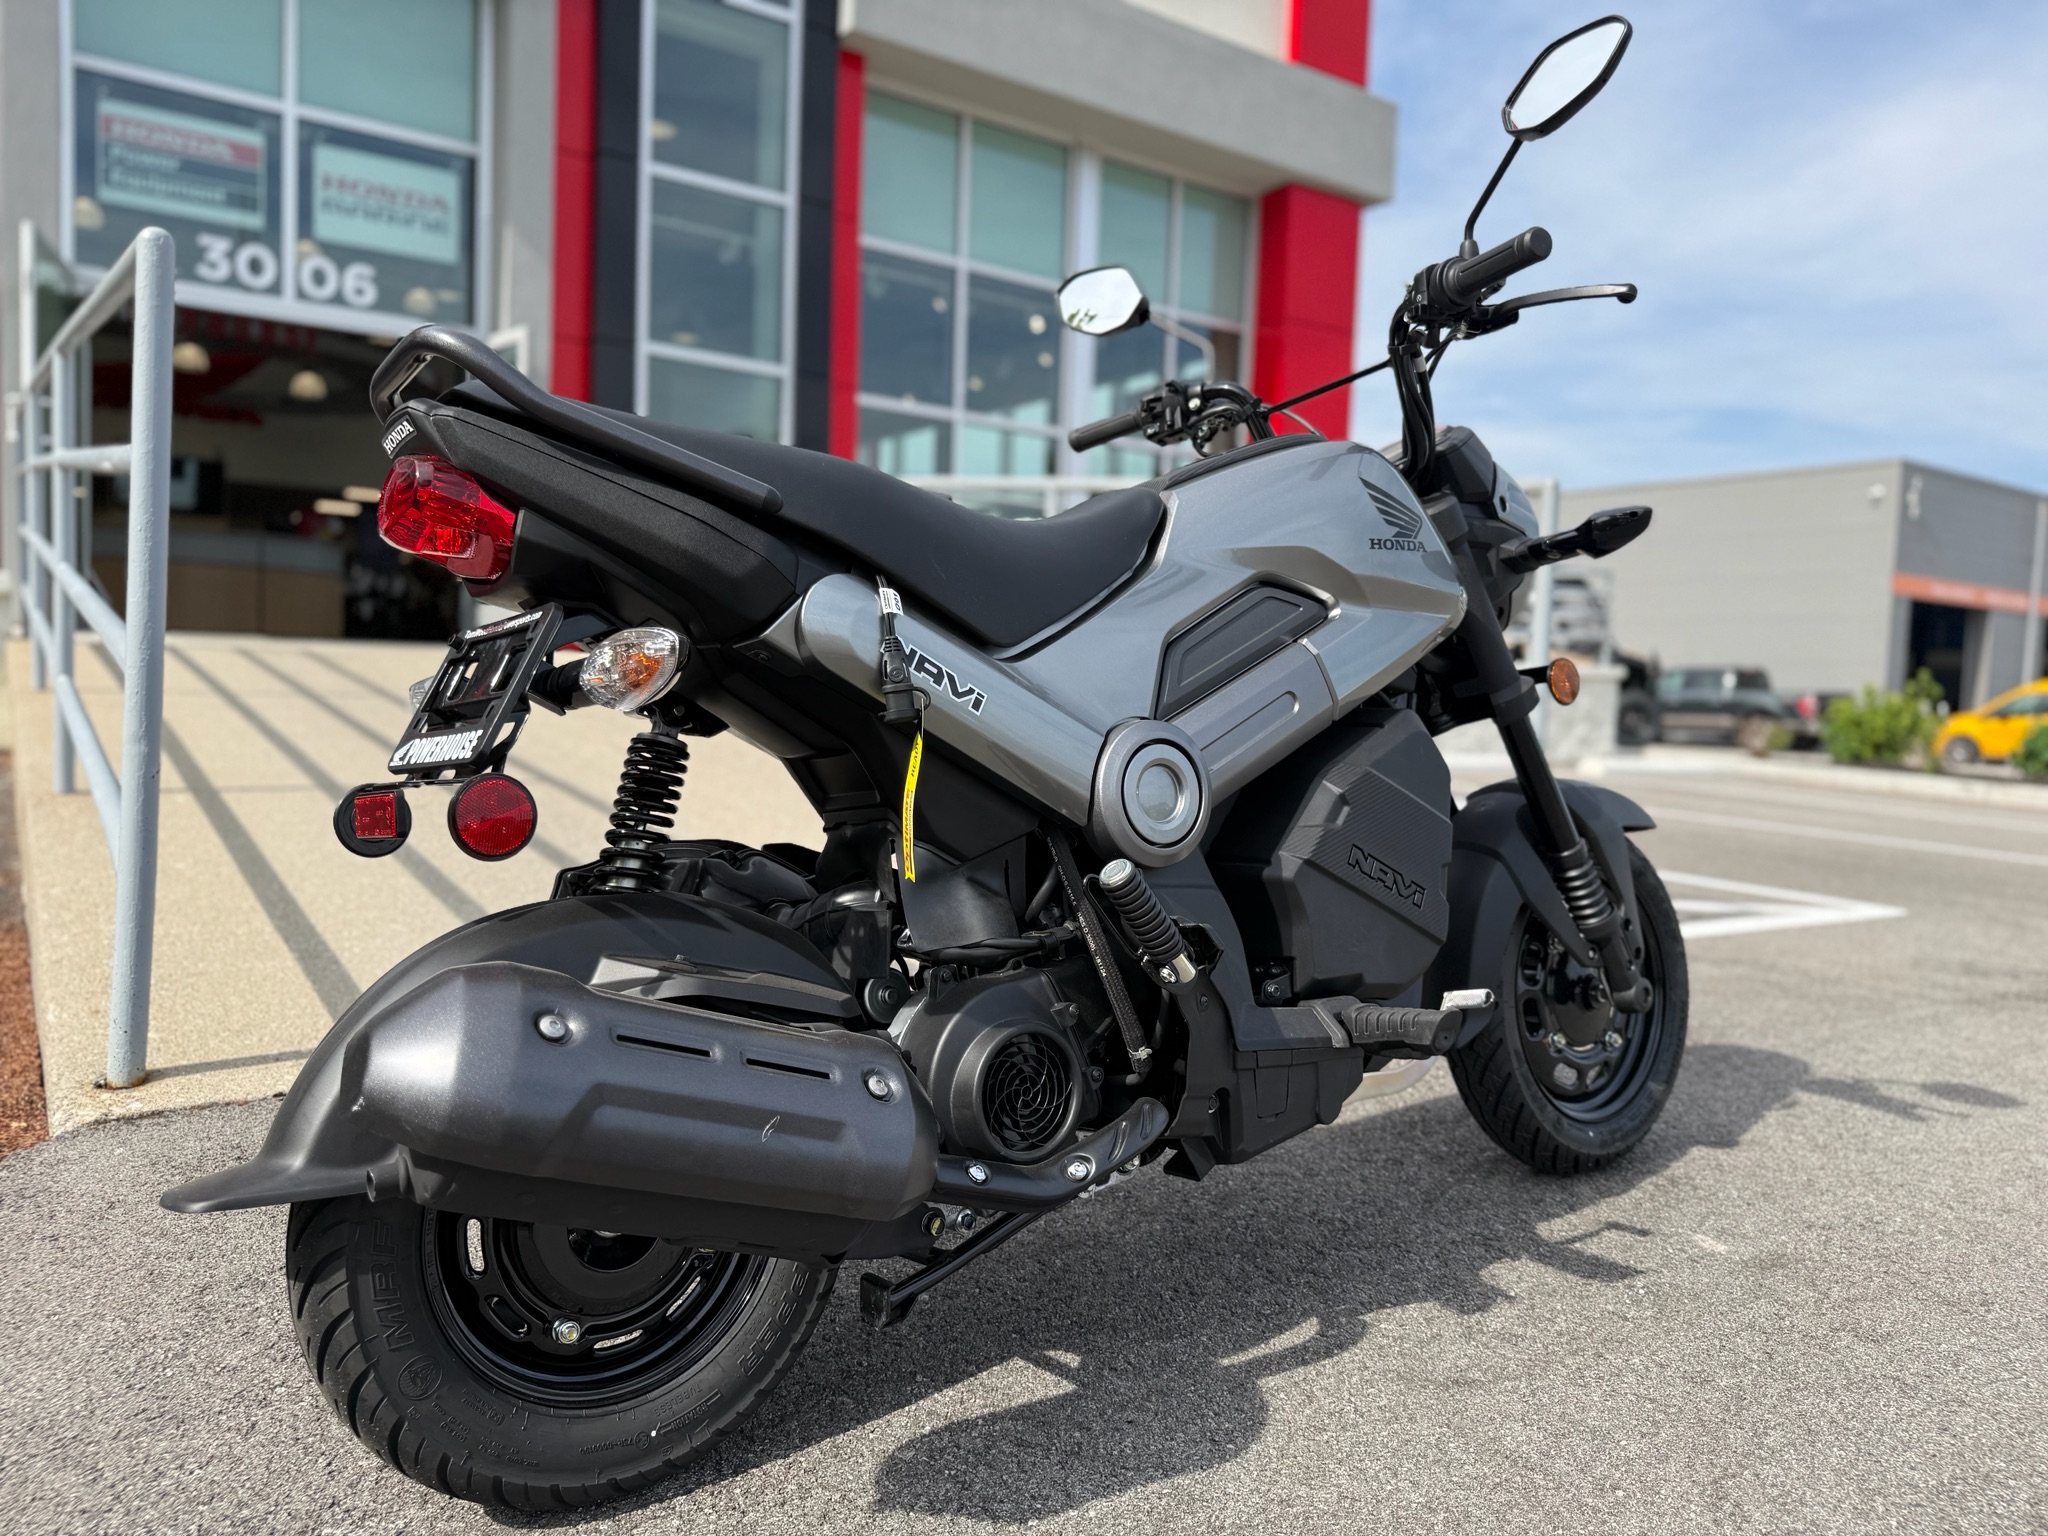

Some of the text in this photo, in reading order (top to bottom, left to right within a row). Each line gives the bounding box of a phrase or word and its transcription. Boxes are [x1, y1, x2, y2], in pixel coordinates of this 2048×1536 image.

[321, 171, 450, 218] HONDA
[383, 420, 414, 455] HONDA
[1368, 538, 1428, 553] HONDA
[403, 729, 484, 765] POWERHOUSE
[368, 1218, 415, 1352] MRF
[652, 1383, 703, 1417] TUBELESS
[670, 1401, 710, 1431] ROTATION
